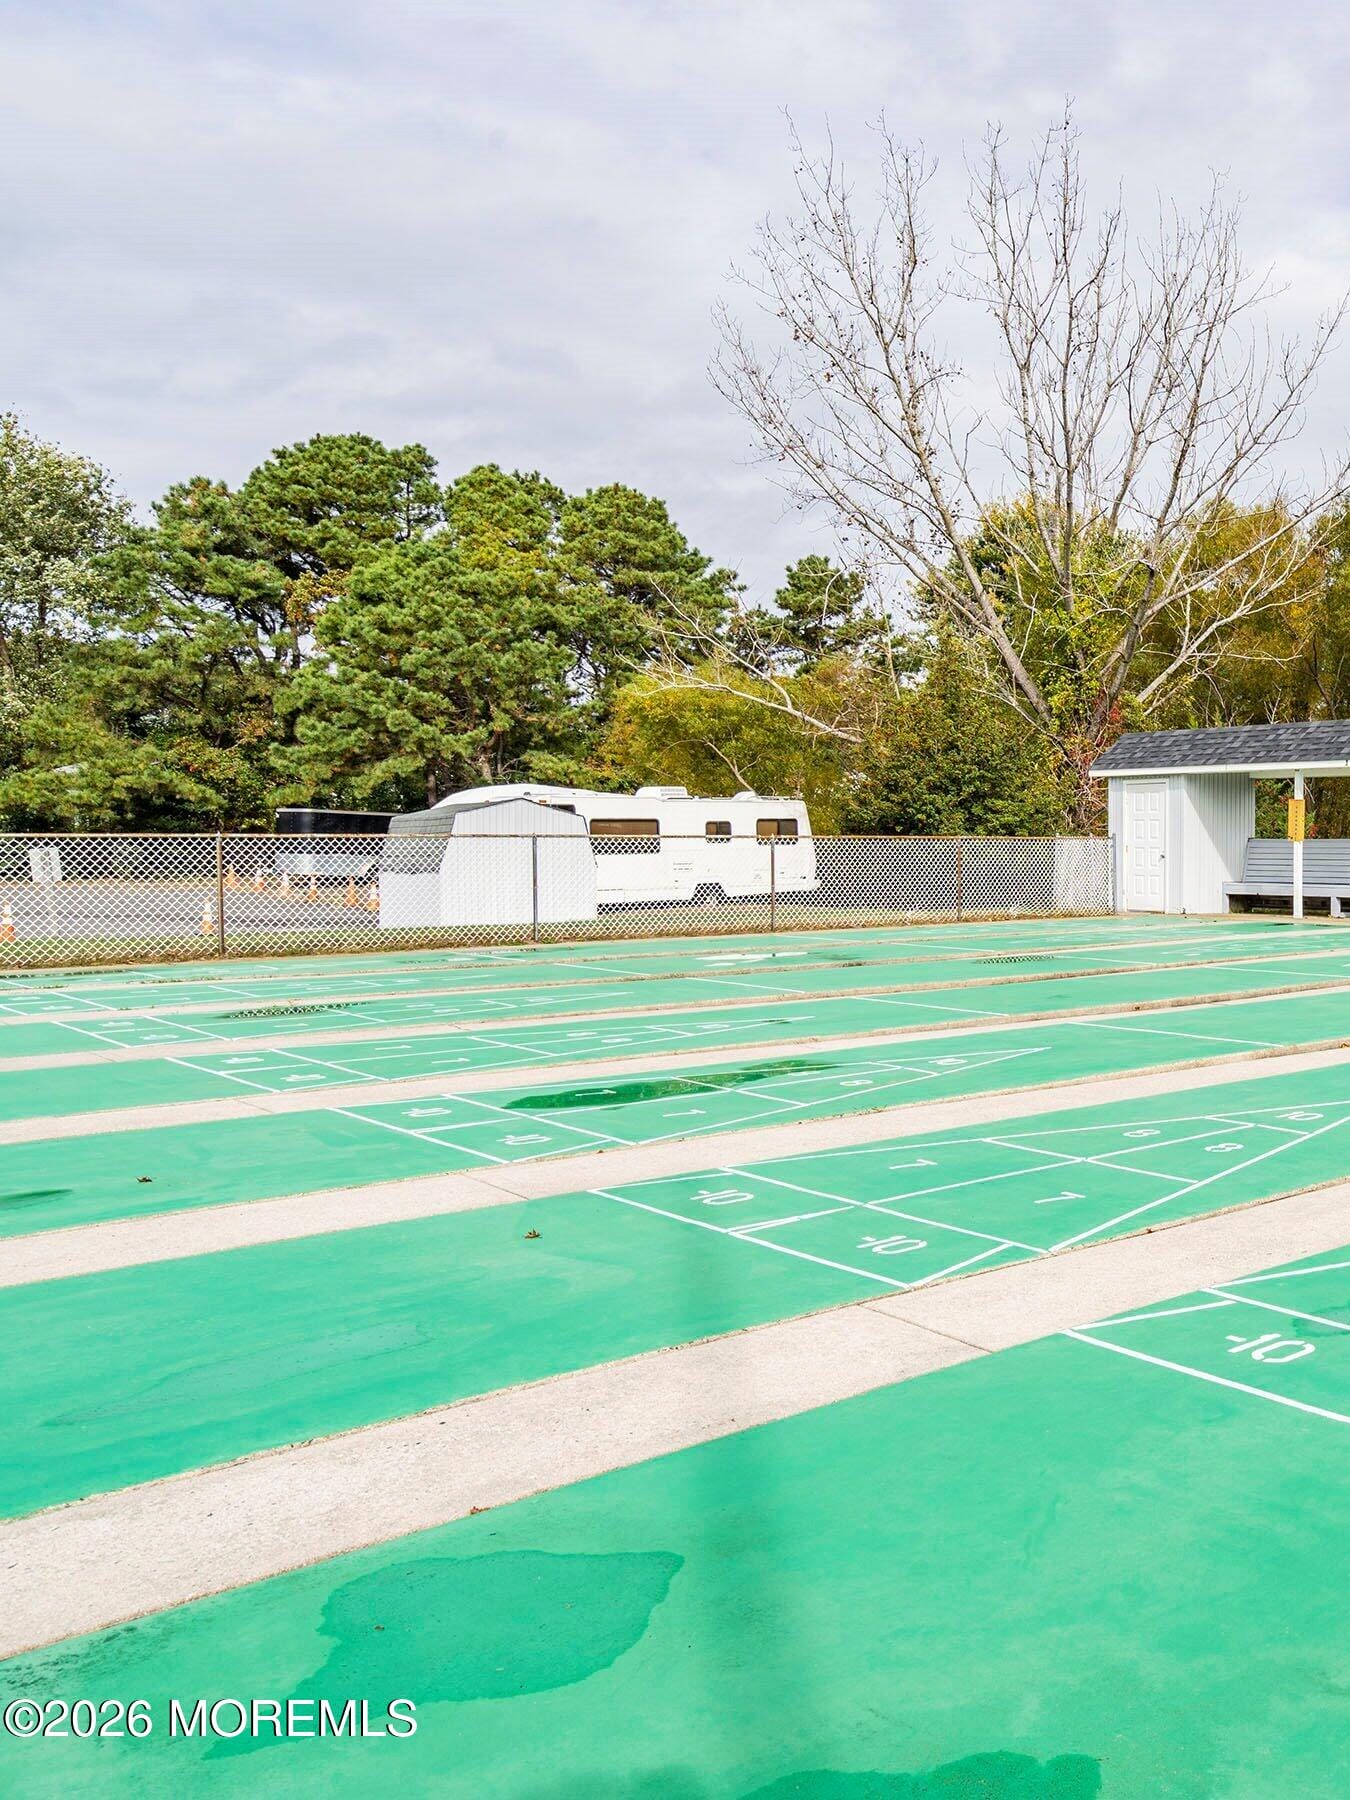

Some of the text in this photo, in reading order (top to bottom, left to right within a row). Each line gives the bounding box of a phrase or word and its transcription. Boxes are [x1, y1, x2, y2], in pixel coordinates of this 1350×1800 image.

[1274, 1110, 1325, 1122] 10
[1122, 1128, 1162, 1138] 8
[1204, 1142, 1245, 1153] 8
[888, 1158, 939, 1171] 7
[1033, 1190, 1086, 1205] 7
[1225, 1332, 1317, 1365] -10
